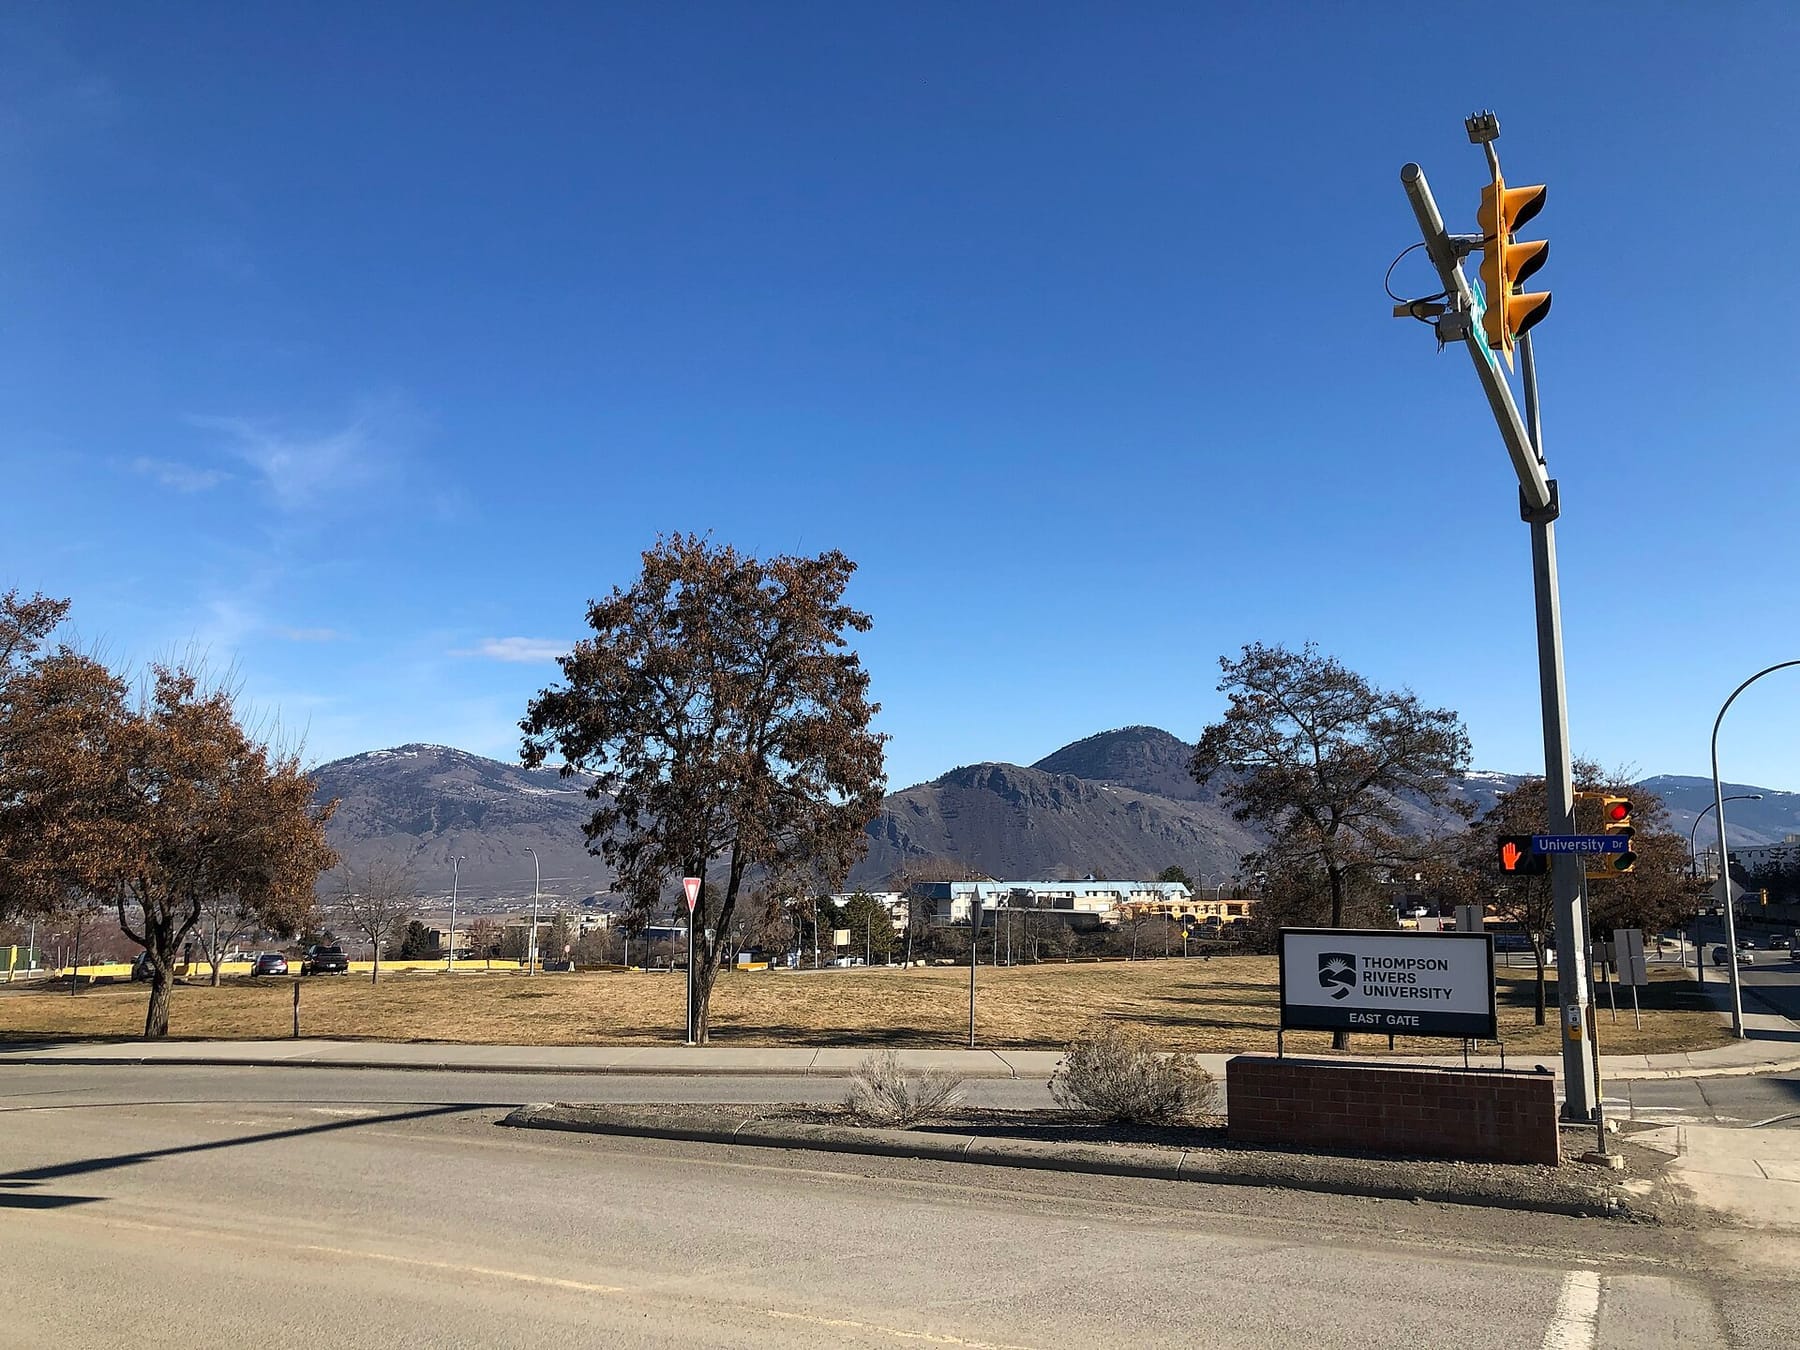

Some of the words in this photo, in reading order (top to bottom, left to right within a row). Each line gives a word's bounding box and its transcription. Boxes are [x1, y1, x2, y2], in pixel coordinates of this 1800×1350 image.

[1539, 839, 1605, 852] University
[1612, 840, 1623, 849] Dr
[1362, 957, 1448, 970] THOMPSON
[1363, 971, 1416, 984] RIVERS
[1363, 985, 1452, 999] UNIVERSITY
[1349, 1013, 1381, 1024] EAST
[1386, 1015, 1420, 1026] GATE
